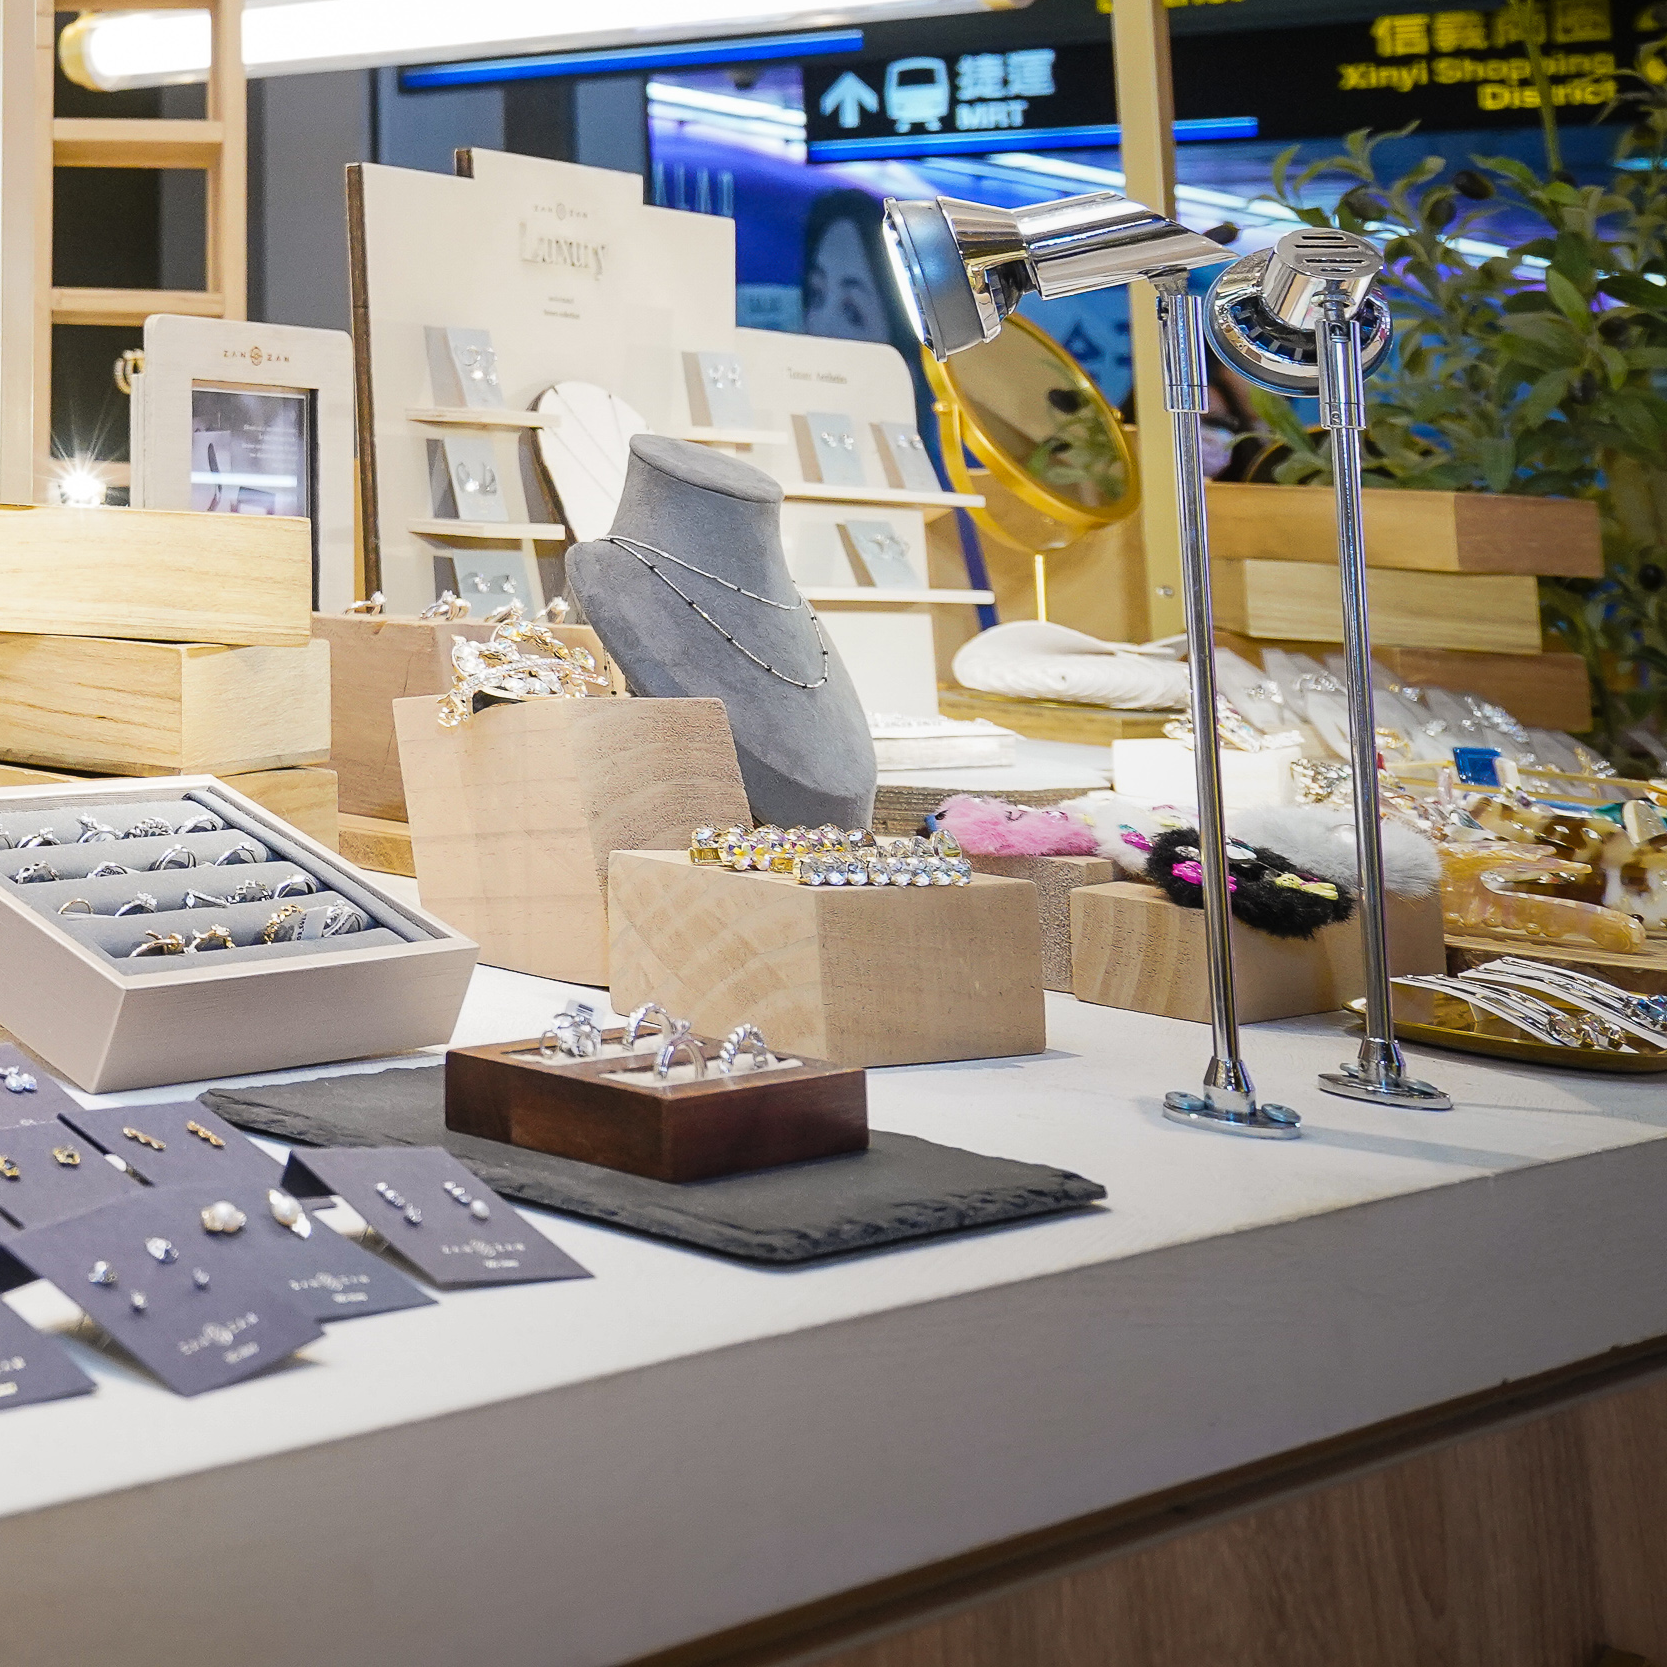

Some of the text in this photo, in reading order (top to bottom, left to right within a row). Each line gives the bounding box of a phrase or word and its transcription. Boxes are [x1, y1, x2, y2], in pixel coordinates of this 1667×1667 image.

[954, 48, 1056, 102] 捷運
[1337, 60, 1430, 93] Xinyi
[955, 100, 1029, 130] MRT
[518, 220, 610, 283] Luxury
[223, 350, 290, 363] ZAN ZAN
